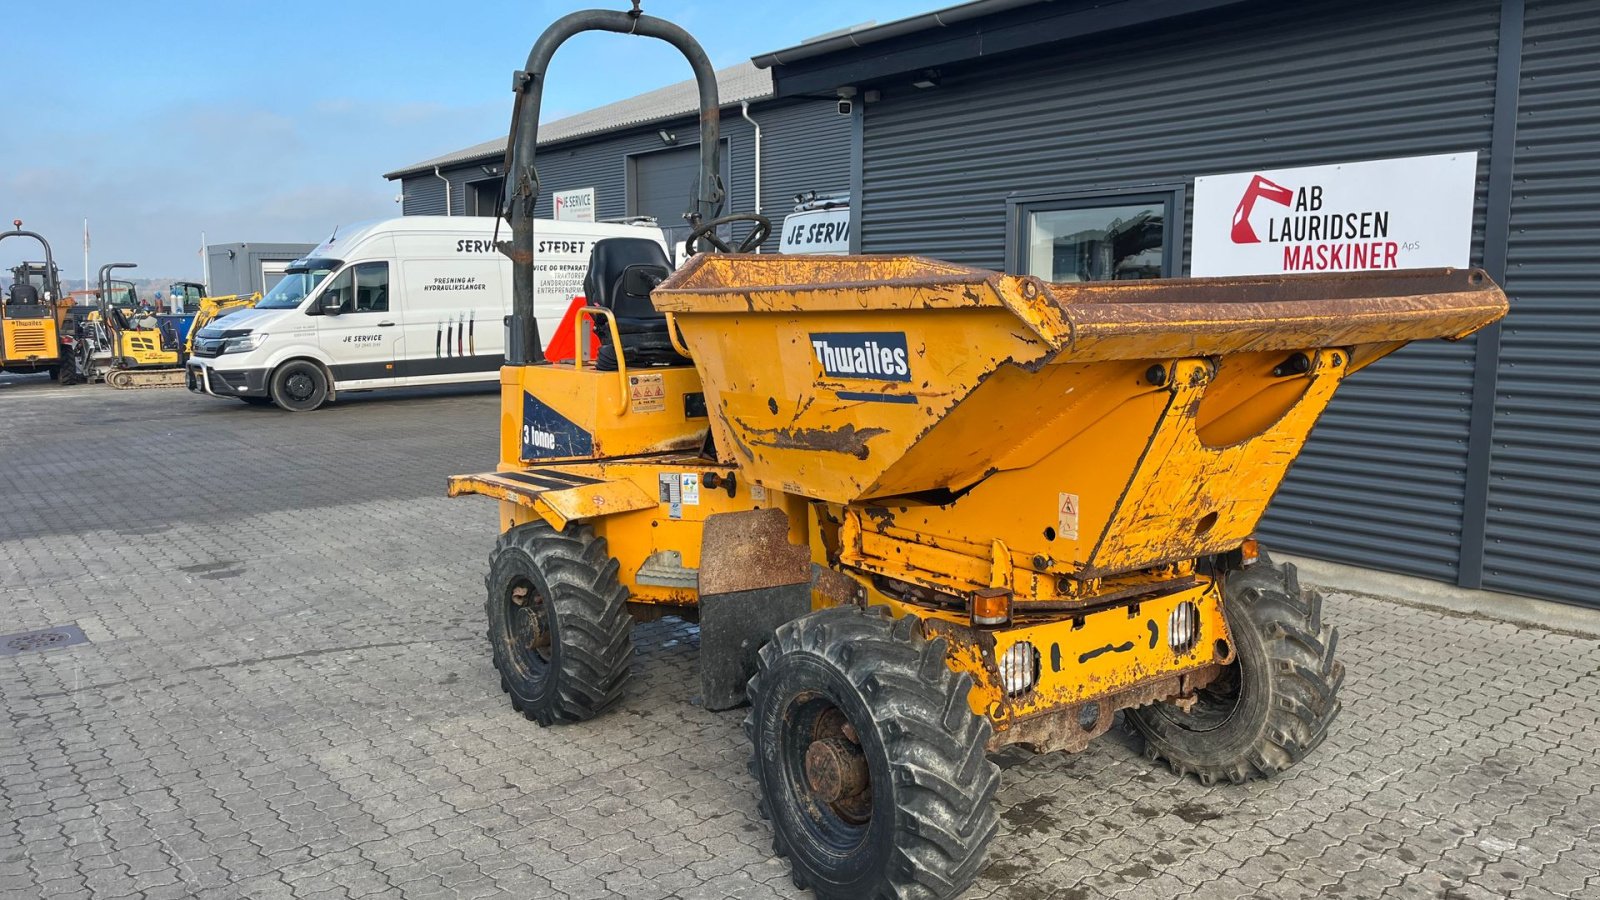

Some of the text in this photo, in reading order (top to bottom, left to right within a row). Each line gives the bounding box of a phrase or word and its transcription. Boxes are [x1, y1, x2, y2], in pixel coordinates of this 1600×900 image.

[569, 194, 591, 207] SERVICE
[1295, 185, 1323, 212] AB
[787, 221, 850, 245] JE SERVI
[1268, 211, 1389, 242] LAURIDSEN
[539, 241, 585, 253] STEDET
[1283, 241, 1420, 271] MASKINER ApS
[540, 279, 584, 287] LANDBRUGSMAS
[343, 334, 382, 343] JE SERVICE
[812, 340, 908, 375] Thwaites
[523, 424, 555, 450] 3 tonne
